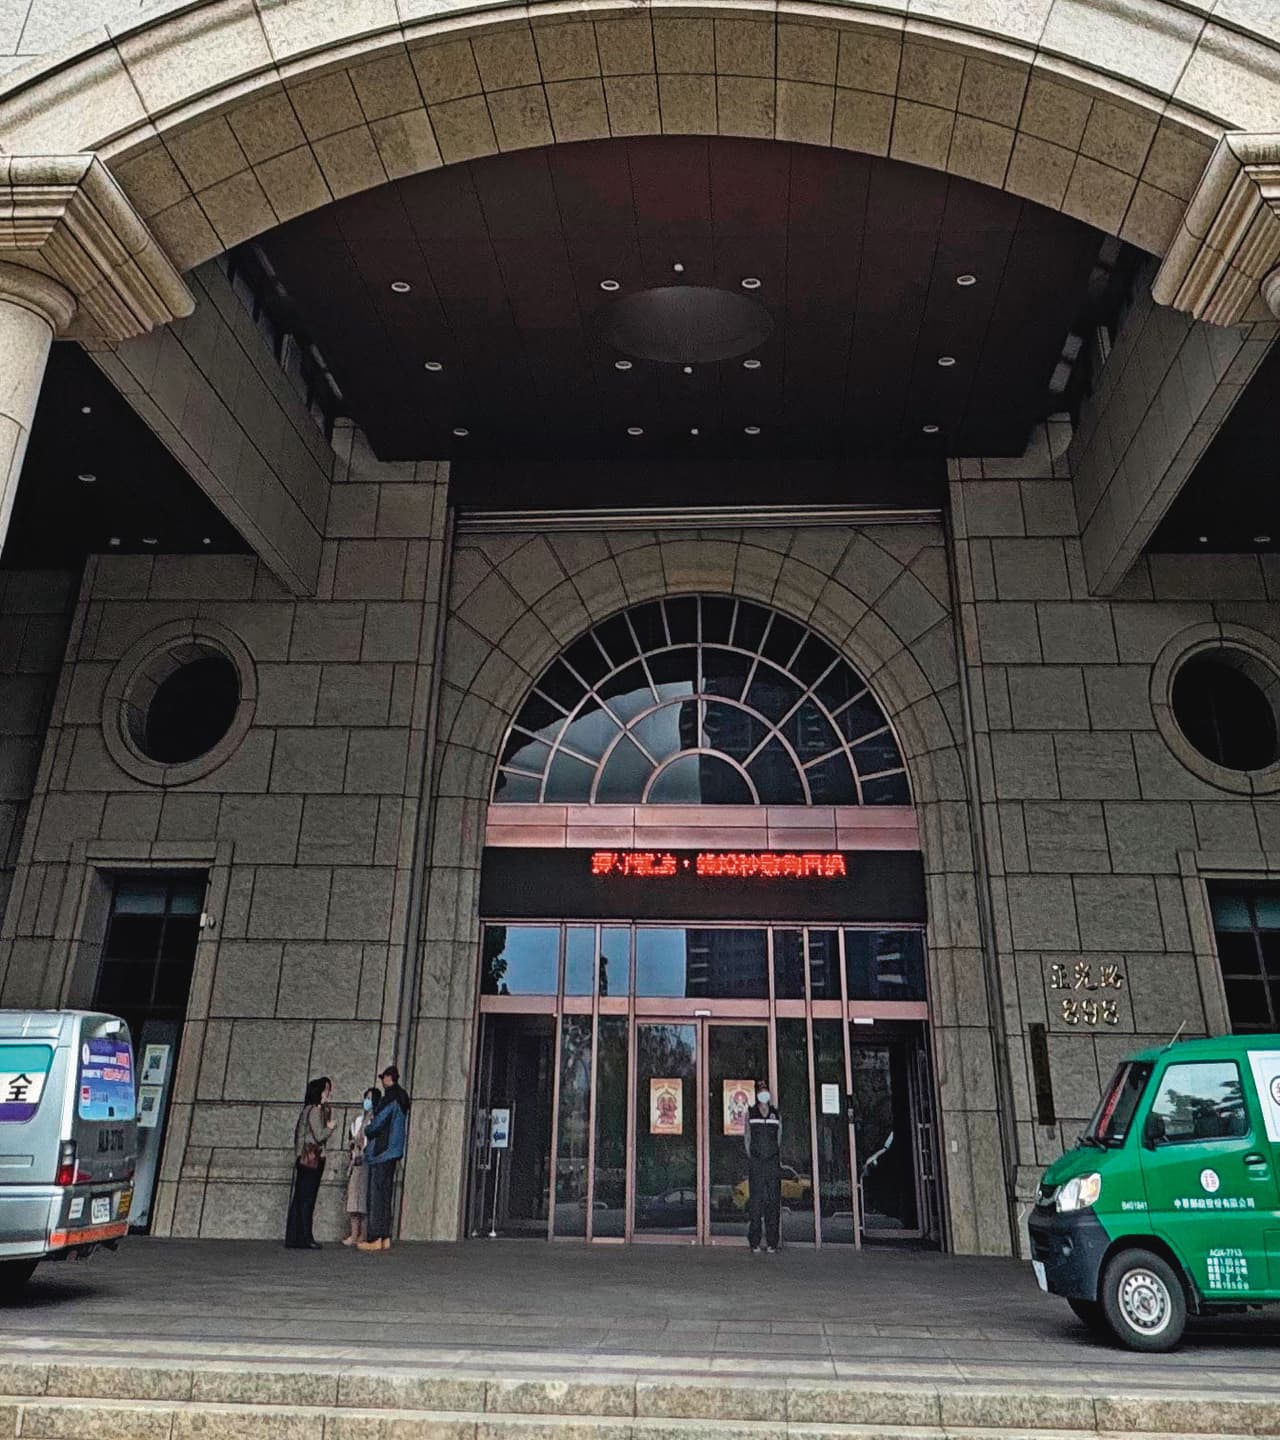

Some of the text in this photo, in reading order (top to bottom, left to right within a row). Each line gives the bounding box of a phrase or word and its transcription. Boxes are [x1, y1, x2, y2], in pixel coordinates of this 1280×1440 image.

[1051, 961, 1123, 991] 正光路
[1063, 999, 1119, 1025] 898
